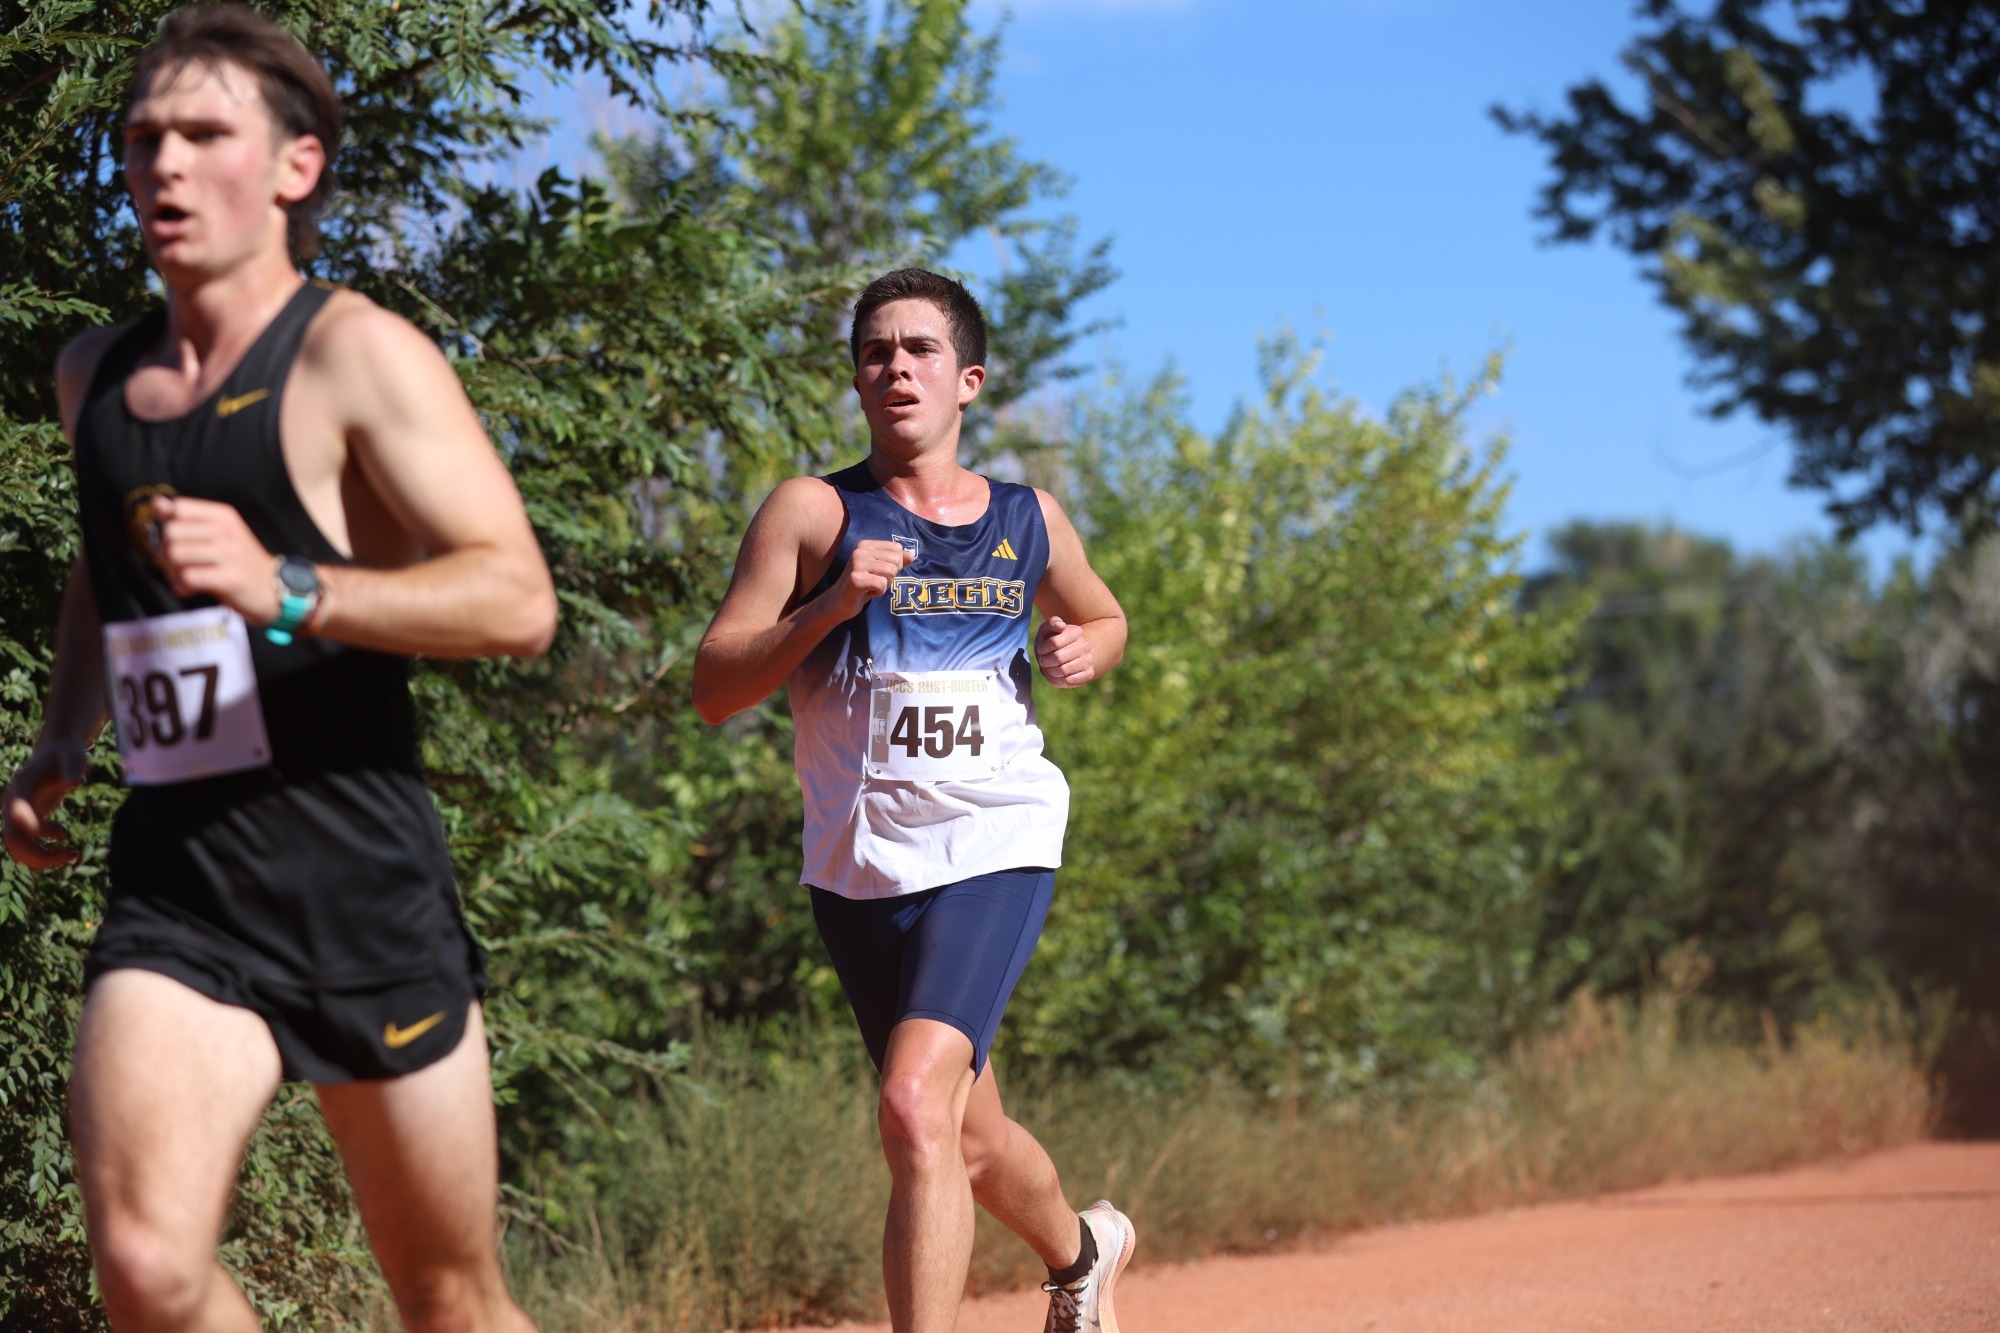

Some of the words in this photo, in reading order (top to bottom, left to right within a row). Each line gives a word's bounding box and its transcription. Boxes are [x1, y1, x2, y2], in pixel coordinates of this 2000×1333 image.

[890, 576, 1025, 619] REGIS
[121, 665, 220, 750] 397
[886, 679, 915, 694] UCCS
[917, 679, 988, 694] RUST-BUSTER
[890, 705, 984, 759] 454
